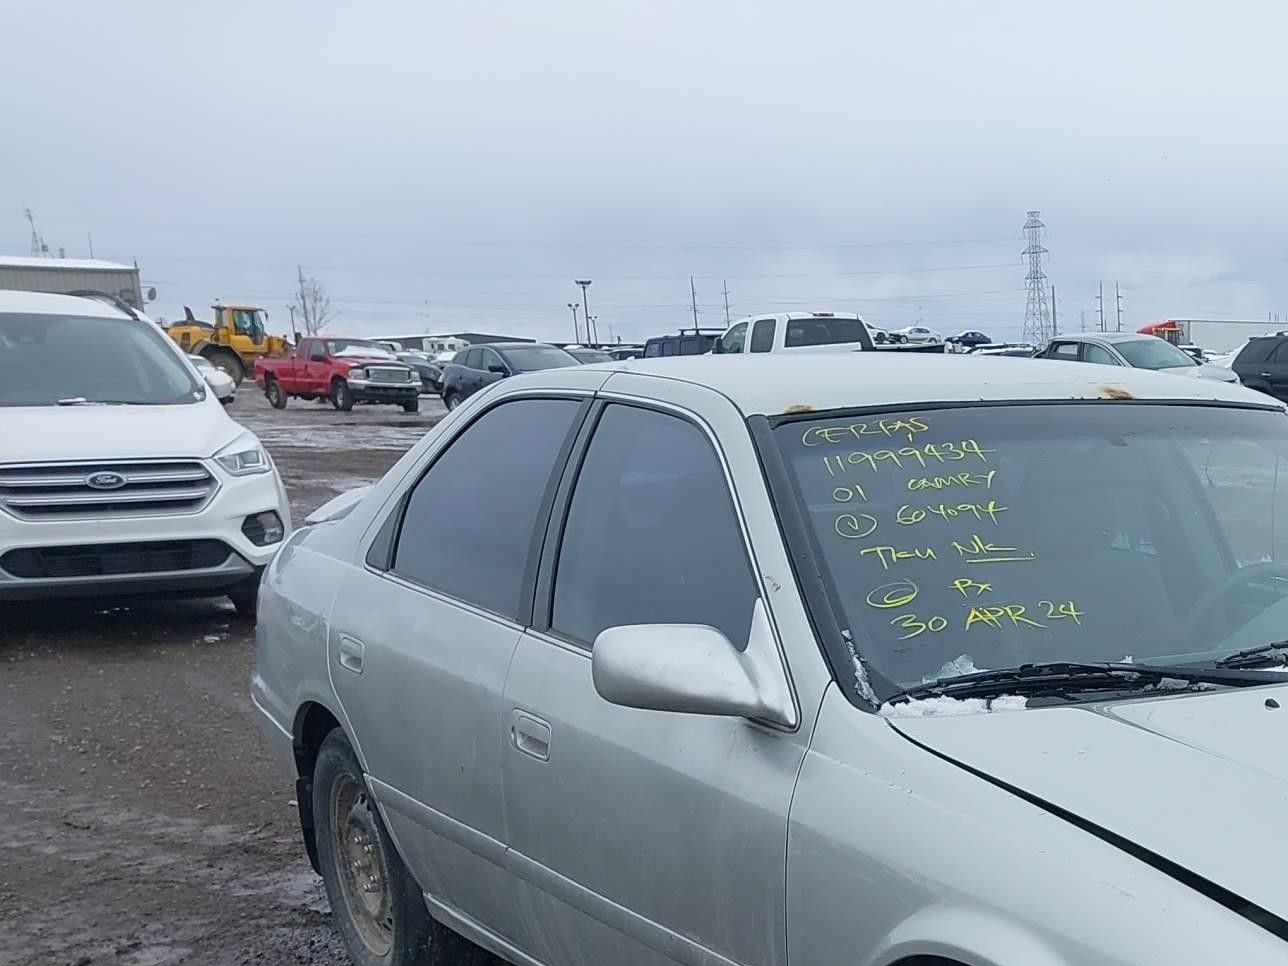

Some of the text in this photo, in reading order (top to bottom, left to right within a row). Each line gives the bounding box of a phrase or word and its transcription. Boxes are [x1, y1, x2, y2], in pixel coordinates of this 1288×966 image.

[823, 439, 997, 477] 11999434
[832, 469, 996, 502] 01 CAMRY
[890, 600, 1086, 640] 30 APR 24
